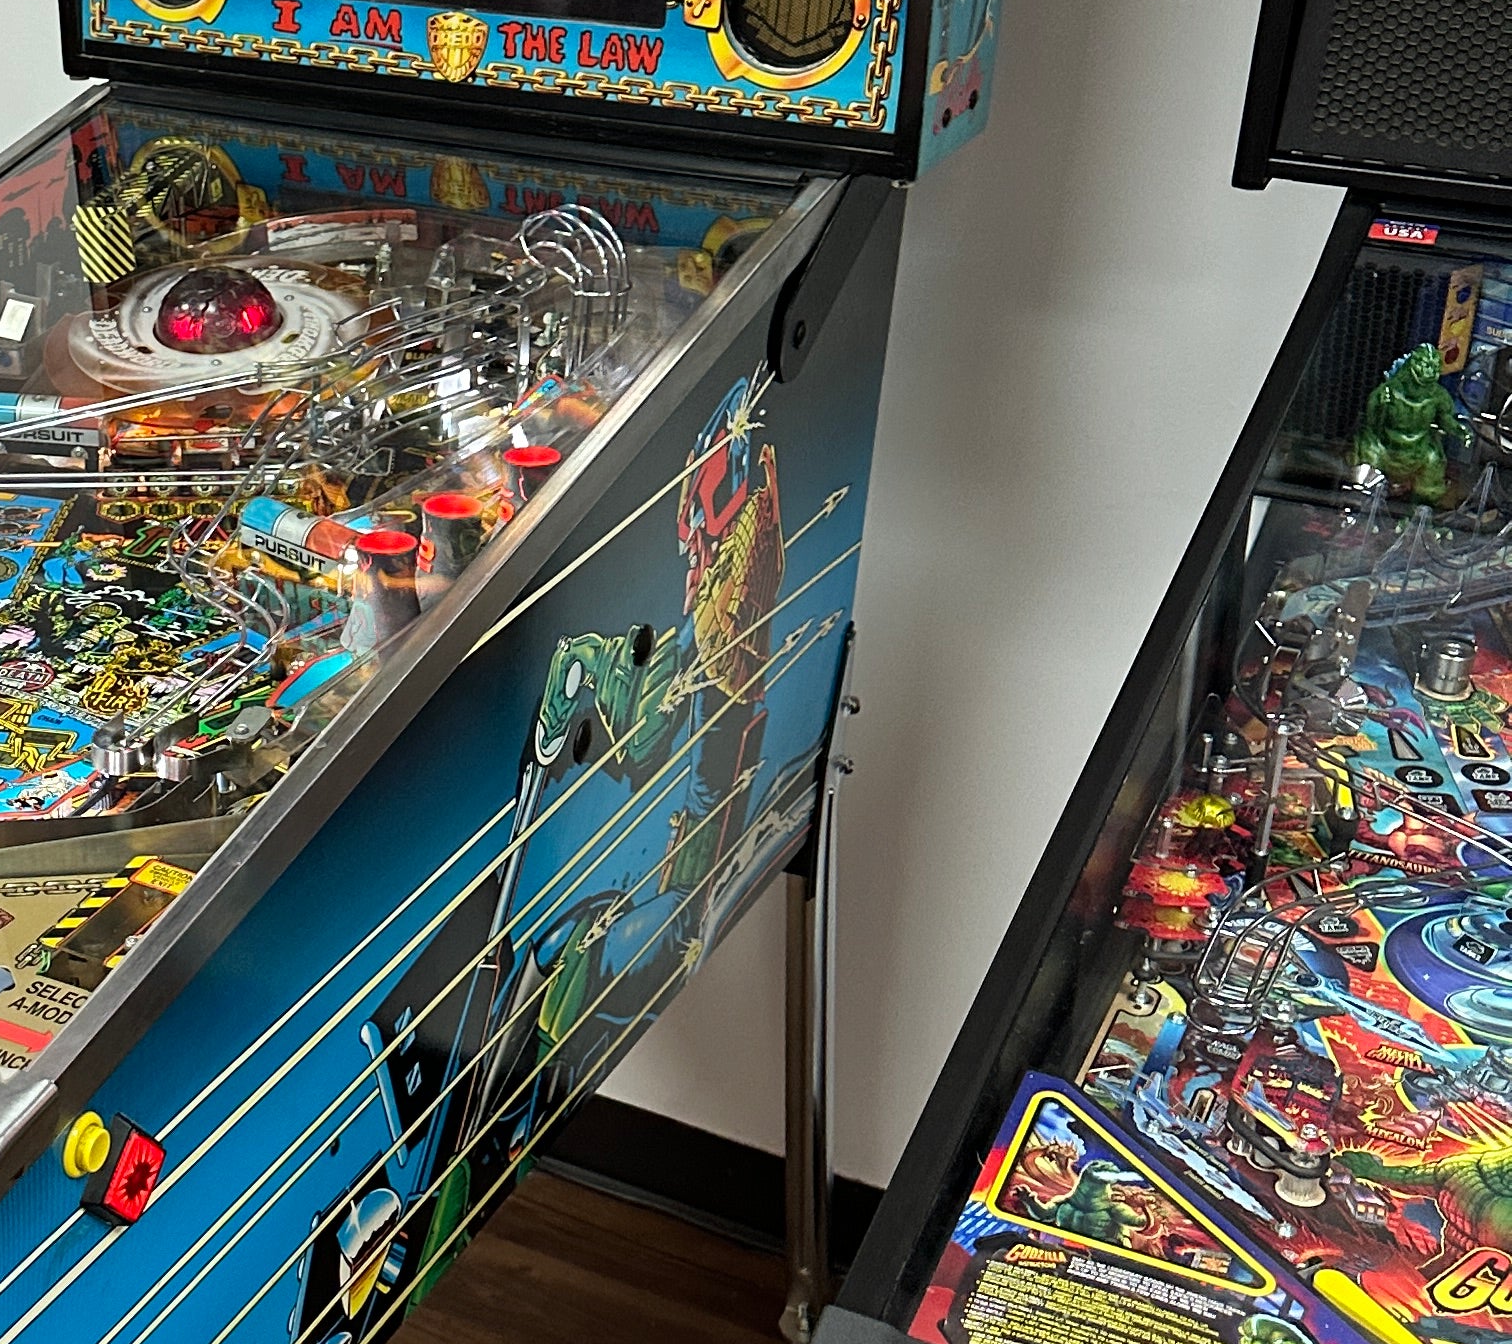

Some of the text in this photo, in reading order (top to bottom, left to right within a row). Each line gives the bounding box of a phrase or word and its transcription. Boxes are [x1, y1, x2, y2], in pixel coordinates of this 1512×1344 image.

[329, 3, 403, 44] AM
[430, 30, 484, 48] DREDD
[498, 21, 664, 75] THE LAW
[1383, 226, 1425, 240] USA
[254, 534, 326, 573] PURSUIT
[97, 691, 141, 709] FIRE
[24, 980, 89, 1010] SELEC
[8, 996, 74, 1026] A-MOD
[1005, 1243, 1068, 1264] GODZILLA
